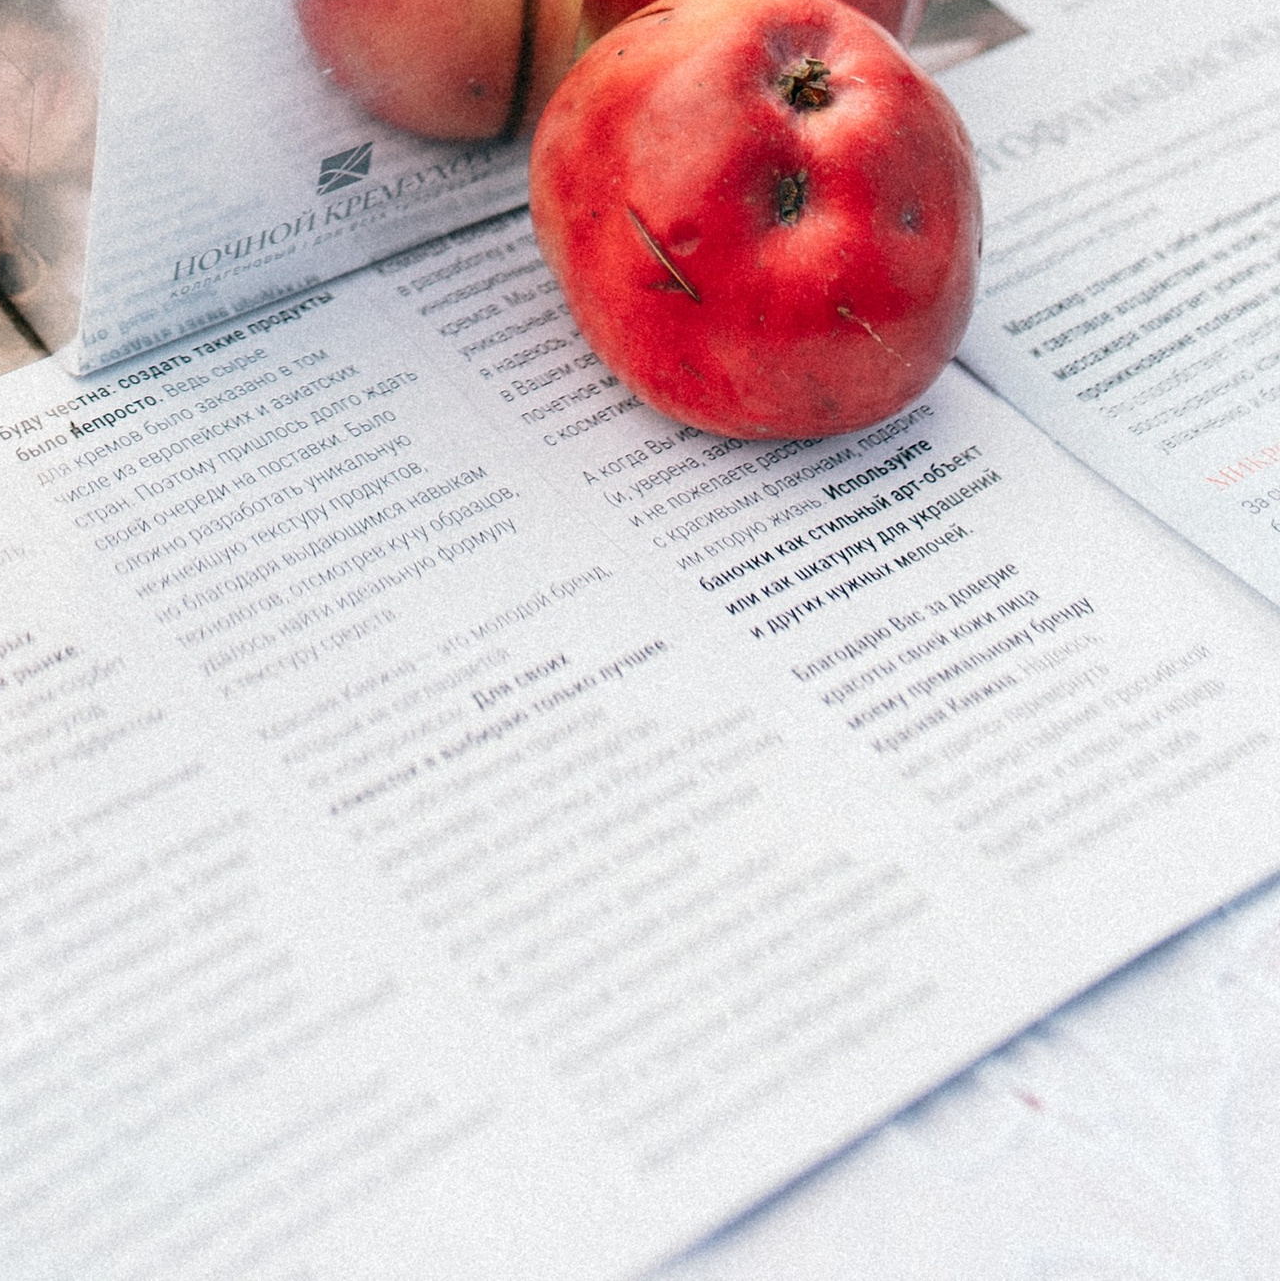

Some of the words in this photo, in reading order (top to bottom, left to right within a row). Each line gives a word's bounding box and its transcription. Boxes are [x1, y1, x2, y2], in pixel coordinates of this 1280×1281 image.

[172, 211, 317, 281] НОЧНОЙ
[11, 432, 69, 462] было
[160, 371, 211, 397] Ведь
[208, 346, 268, 378] сырье
[43, 383, 118, 421] честна:
[115, 350, 194, 390] создать
[191, 328, 247, 357] такие
[245, 290, 335, 334] продукты
[498, 390, 515, 401] в
[510, 363, 575, 395] Вашем
[520, 383, 602, 424] почетное
[33, 461, 72, 486] для
[71, 429, 146, 467] кремов
[139, 407, 195, 436] было
[193, 370, 280, 414] заказано
[277, 364, 294, 377] в
[292, 348, 330, 370] том
[52, 474, 112, 506] числе
[110, 462, 138, 480] из
[136, 411, 255, 469] европейских
[254, 404, 271, 417] и
[269, 364, 361, 410] азиатских
[72, 497, 137, 529] стран.
[132, 459, 220, 501] Поэтому
[216, 417, 310, 465] пришлось
[308, 394, 364, 426] долго
[362, 369, 420, 400] ждать
[541, 434, 558, 446] с
[578, 469, 601, 485] А
[597, 449, 650, 478] когда
[643, 436, 677, 454] Вы
[1204, 444, 1280, 491] МИКР
[92, 515, 153, 552] своей
[150, 484, 231, 526] очереди
[230, 472, 258, 490] на
[256, 434, 346, 478] поставки.
[342, 409, 397, 438] Было
[113, 535, 189, 575] сложно
[186, 483, 304, 545] разработать
[302, 433, 413, 493] уникальную
[133, 541, 249, 599] нежнейшую
[248, 504, 332, 546] текстуру
[327, 461, 430, 511] продуктов,
[627, 515, 644, 527] и
[642, 503, 669, 520] не
[665, 461, 759, 508] пожелаете
[628, 456, 709, 497] уверена,
[651, 536, 668, 548] с
[665, 491, 765, 542] красивыми
[757, 447, 863, 500] флаконами,
[856, 404, 936, 450] подарите
[674, 551, 706, 570] им
[703, 521, 770, 557] вторую
[766, 496, 827, 527] жизнь.
[821, 439, 934, 500] Используйте
[694, 550, 776, 591] баночки
[773, 535, 808, 556] как
[805, 492, 892, 541] стильный
[888, 445, 985, 501] арт-объект
[1241, 496, 1270, 515] За
[178, 559, 282, 611] благодаря
[279, 502, 408, 566] выдающимся
[405, 465, 488, 508] навыкам
[287, 545, 388, 597] отсмотрев
[385, 526, 433, 552] кучу
[428, 487, 522, 532] образцов,
[333, 556, 438, 610] идеальную
[432, 518, 522, 566] формулу
[723, 592, 762, 615] или
[759, 576, 795, 597] как
[793, 537, 882, 582] шкатулку
[874, 521, 910, 545] для
[906, 466, 1002, 529] украшений
[748, 626, 766, 639] и
[763, 596, 827, 633] других
[824, 562, 894, 601] нужных
[891, 522, 974, 568] мелочей.
[789, 627, 894, 682] Благодарю
[886, 610, 927, 632] Вас
[923, 600, 949, 616] за
[944, 563, 1022, 607] доверие
[818, 660, 900, 705] красоты
[896, 630, 952, 666] своей
[947, 611, 997, 639] кожи
[993, 589, 1041, 616] лица
[844, 692, 912, 730] моему
[904, 628, 1036, 698] премиальному
[1024, 596, 1098, 633] бренду
[866, 708, 950, 755] Красная
